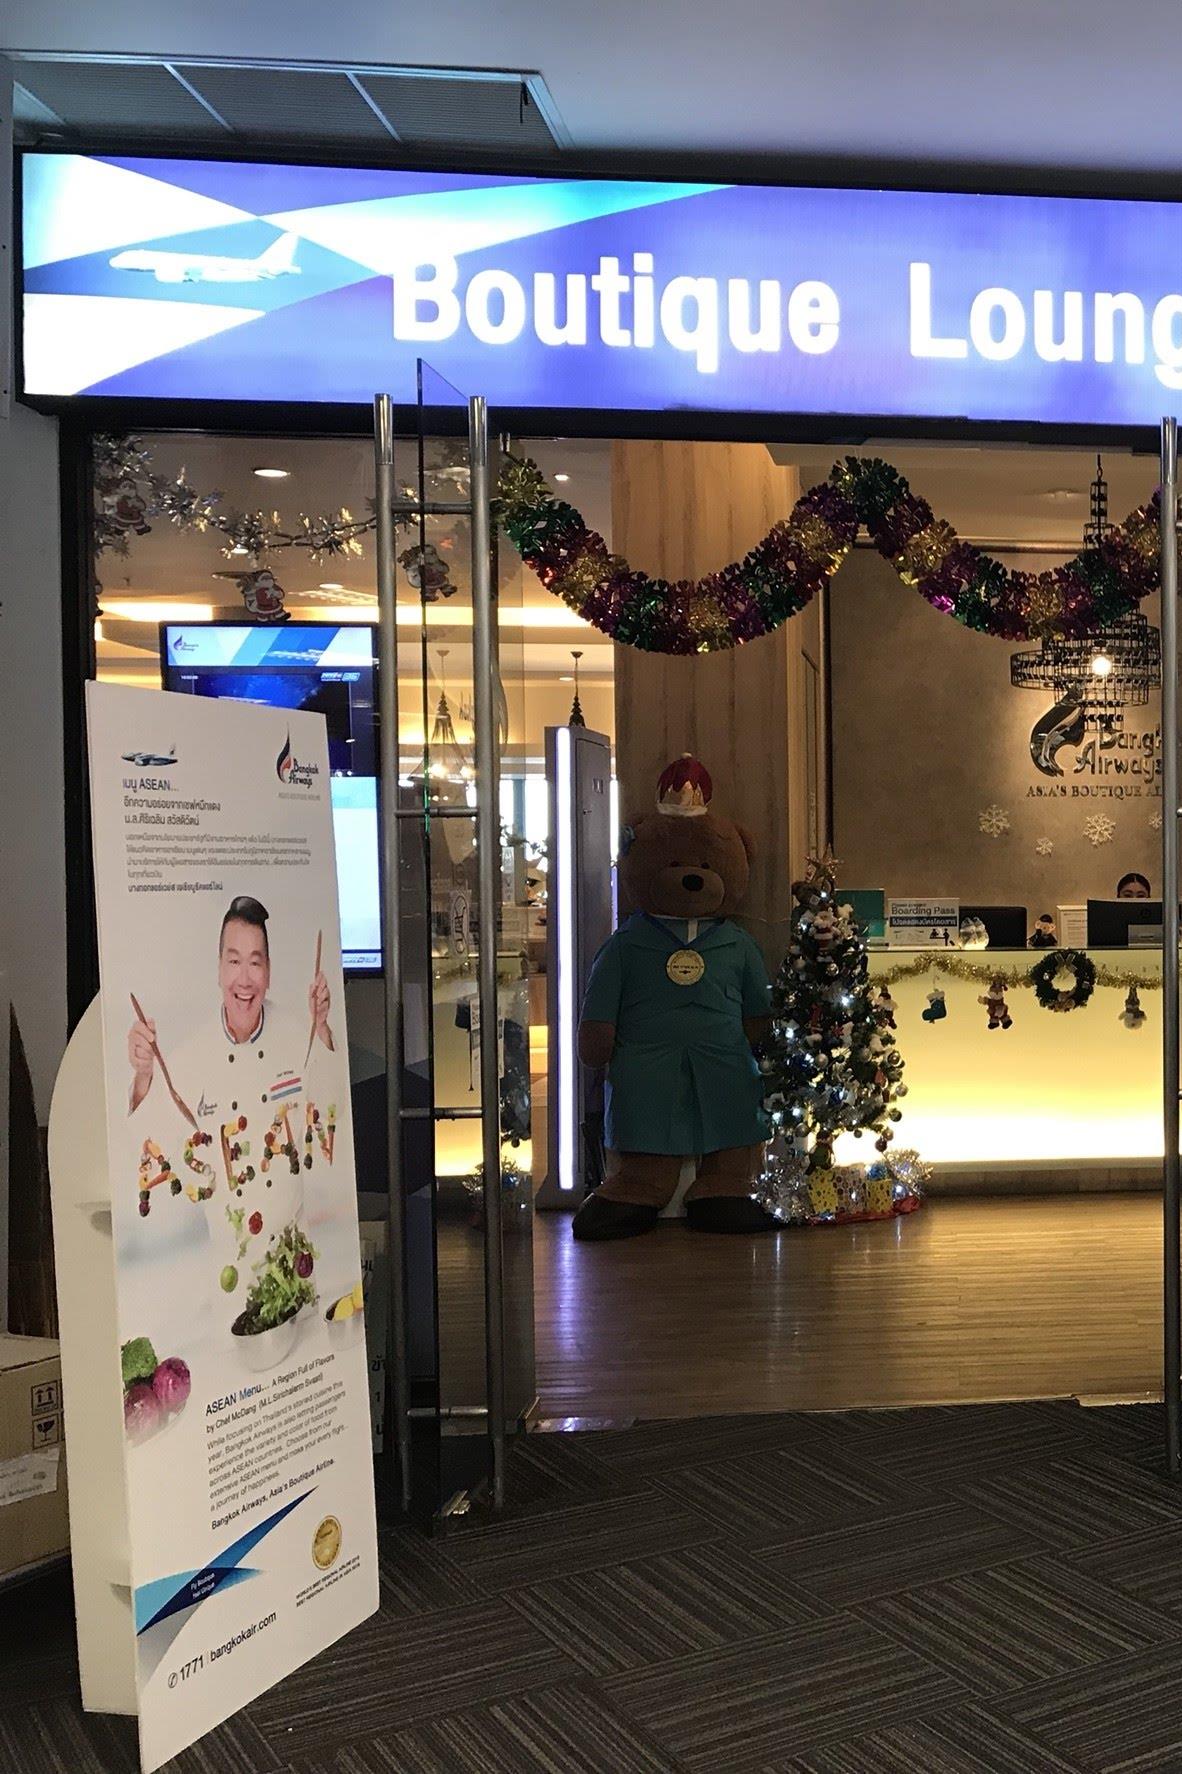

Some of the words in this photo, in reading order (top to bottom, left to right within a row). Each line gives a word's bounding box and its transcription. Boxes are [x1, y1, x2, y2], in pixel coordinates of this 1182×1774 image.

[394, 252, 841, 374] Boutique
[1072, 785, 1142, 800] BOUTIQUE
[892, 906, 932, 915] Boarding
[934, 907, 955, 915] Pass
[139, 1102, 336, 1216] ASEAN
[206, 1393, 237, 1416] ASEAN
[215, 1413, 231, 1428] Chef
[232, 1458, 253, 1475] ASEAN
[240, 1466, 260, 1483] ASEAN
[211, 1506, 240, 1529] Bangkok
[289, 1468, 315, 1487] Boutique
[180, 1655, 204, 1681] 1771
[210, 1612, 277, 1662] bangkokair.com
